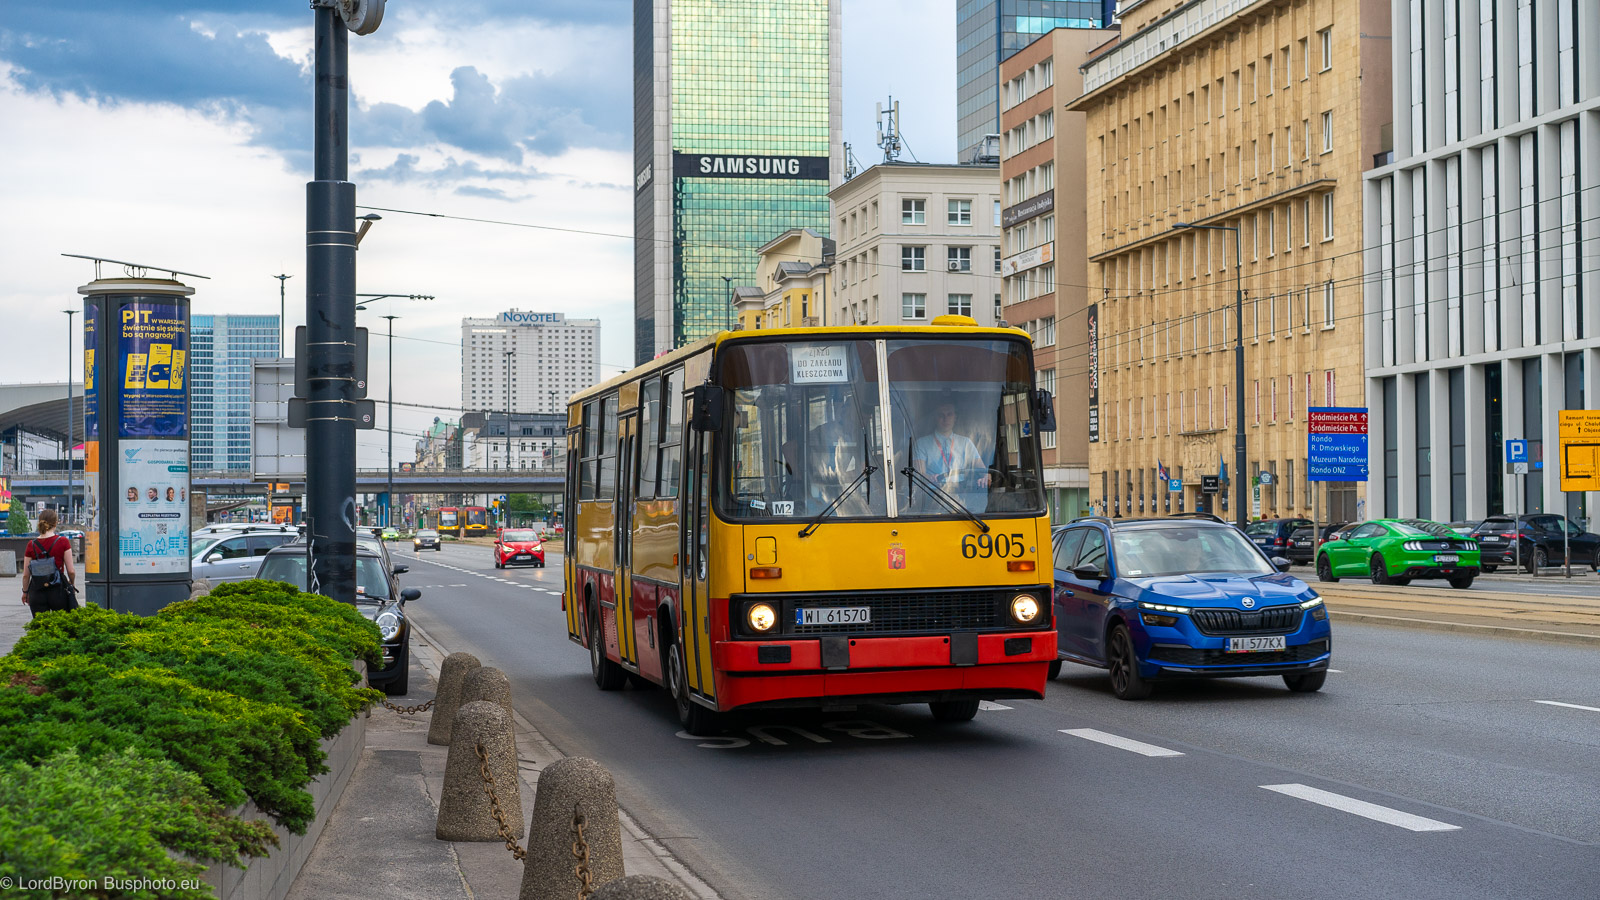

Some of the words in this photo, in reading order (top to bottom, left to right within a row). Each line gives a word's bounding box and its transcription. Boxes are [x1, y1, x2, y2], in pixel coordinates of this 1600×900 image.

[700, 157, 800, 175] SAMSUNG
[636, 163, 652, 191] SAMSUNG
[122, 310, 152, 323] PIT
[503, 312, 560, 323] NOVOTEL
[797, 360, 808, 368] DO
[810, 359, 842, 367] ZAKŁADU
[797, 369, 844, 378] KLESZCZOWA
[1310, 412, 1348, 422] Śródmieście
[1310, 423, 1348, 432] Śródmieście
[1311, 435, 1333, 443] Rondo
[1319, 444, 1360, 454] Dmowskiego
[1510, 442, 1524, 460] P
[1311, 455, 1337, 463] Muzeum
[1310, 466, 1332, 474] Rondo
[1332, 466, 1346, 474] ONZ
[774, 503, 792, 514] M2
[961, 533, 1025, 559] 6905
[805, 610, 820, 623] WI
[827, 609, 867, 622] 61570
[1232, 639, 1245, 650] WI
[1250, 637, 1284, 649] 577KX
[674, 719, 915, 749] BUS
